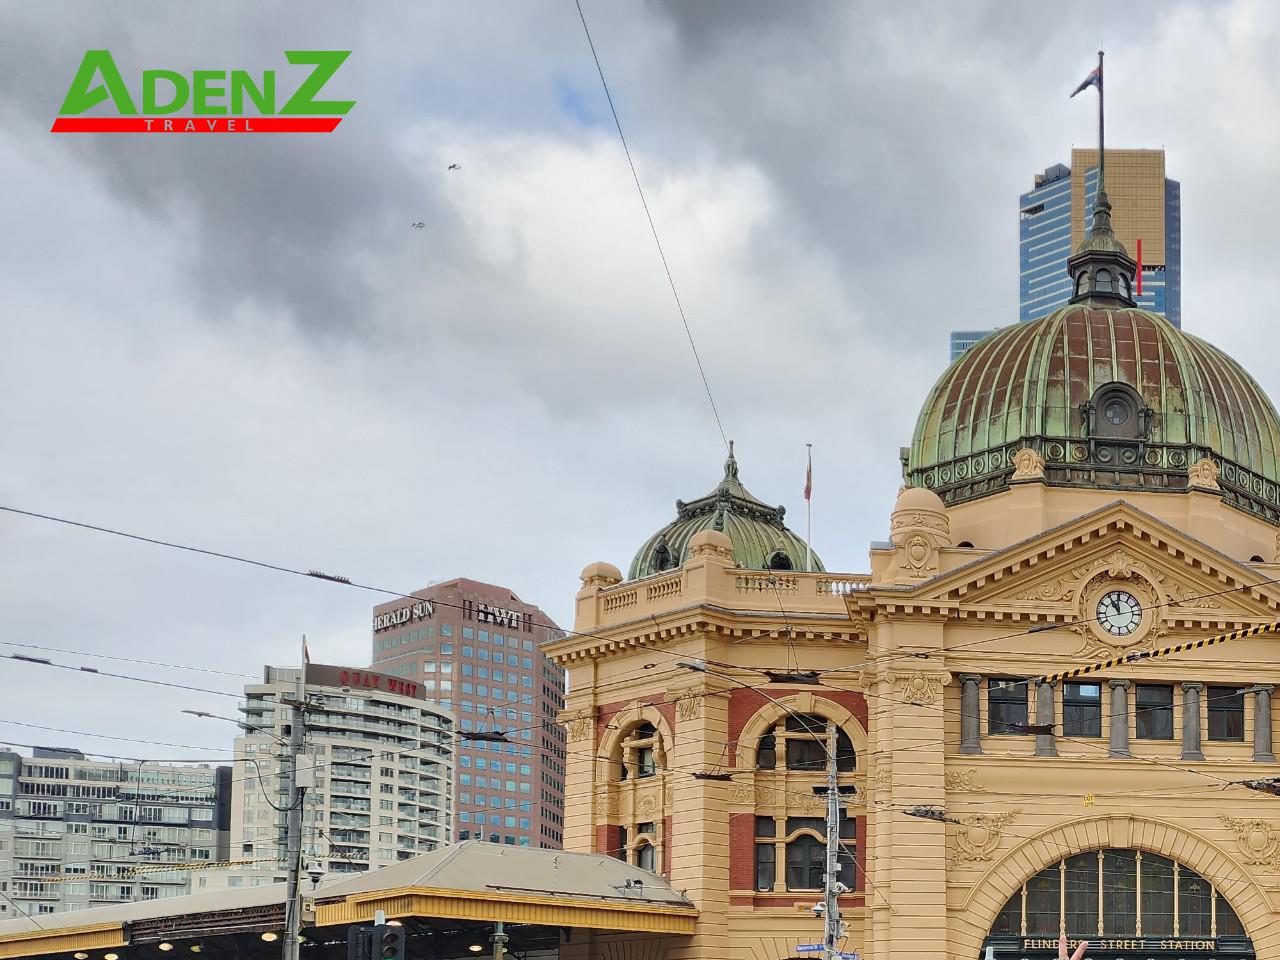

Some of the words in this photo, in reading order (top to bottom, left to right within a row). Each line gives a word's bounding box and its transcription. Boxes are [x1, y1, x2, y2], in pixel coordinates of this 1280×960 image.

[413, 600, 434, 619] SUN
[339, 671, 380, 688] QUAY
[387, 678, 417, 698] WEST
[1100, 939, 1147, 950] STREET
[1160, 940, 1216, 951] STATION
